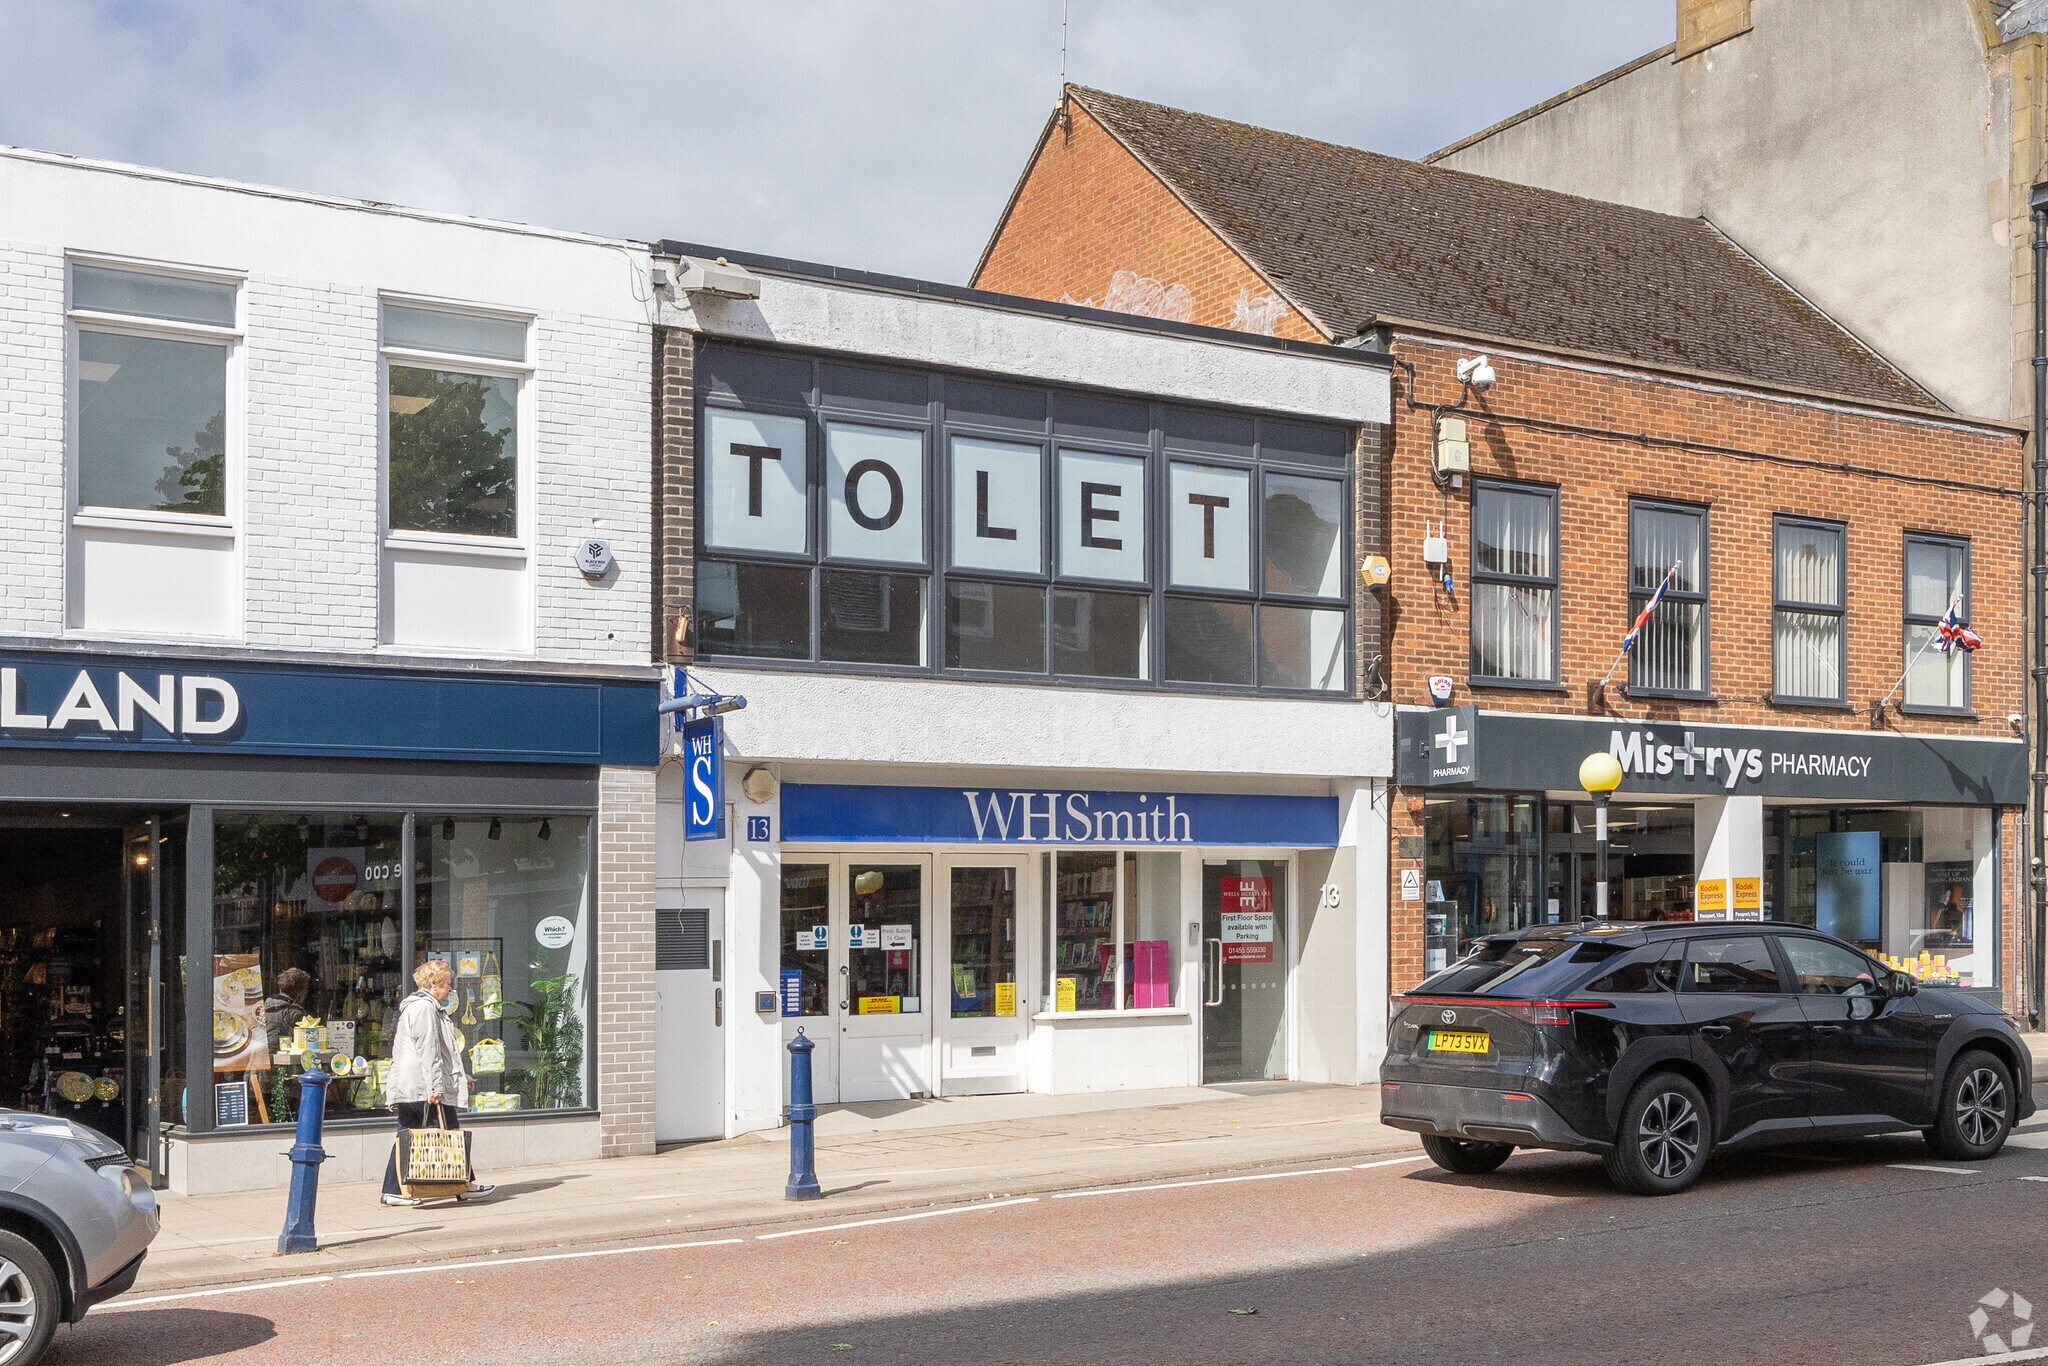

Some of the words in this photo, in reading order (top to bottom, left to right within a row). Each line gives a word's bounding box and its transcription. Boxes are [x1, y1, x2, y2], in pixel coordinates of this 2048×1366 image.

[976, 470, 1230, 559] LET
[1, 667, 239, 734] LAND
[691, 734, 712, 756] WH
[1433, 765, 1470, 778] PHARMACY
[1771, 753, 1872, 778] PHARMACY
[692, 756, 714, 826] S
[963, 791, 1194, 843] WHSmith
[750, 819, 769, 840] 13
[1830, 858, 1838, 867] It
[1839, 858, 1865, 867] could
[1822, 868, 1838, 877] just
[1320, 883, 1340, 908] 13
[1700, 884, 1719, 892] Kodak
[1700, 892, 1724, 900] Express
[1736, 890, 1758, 898] Express
[1255, 914, 1272, 922] Space
[1236, 933, 1259, 941] Parking
[1434, 1034, 1462, 1048] LP73
[1464, 1035, 1487, 1050] SVX
